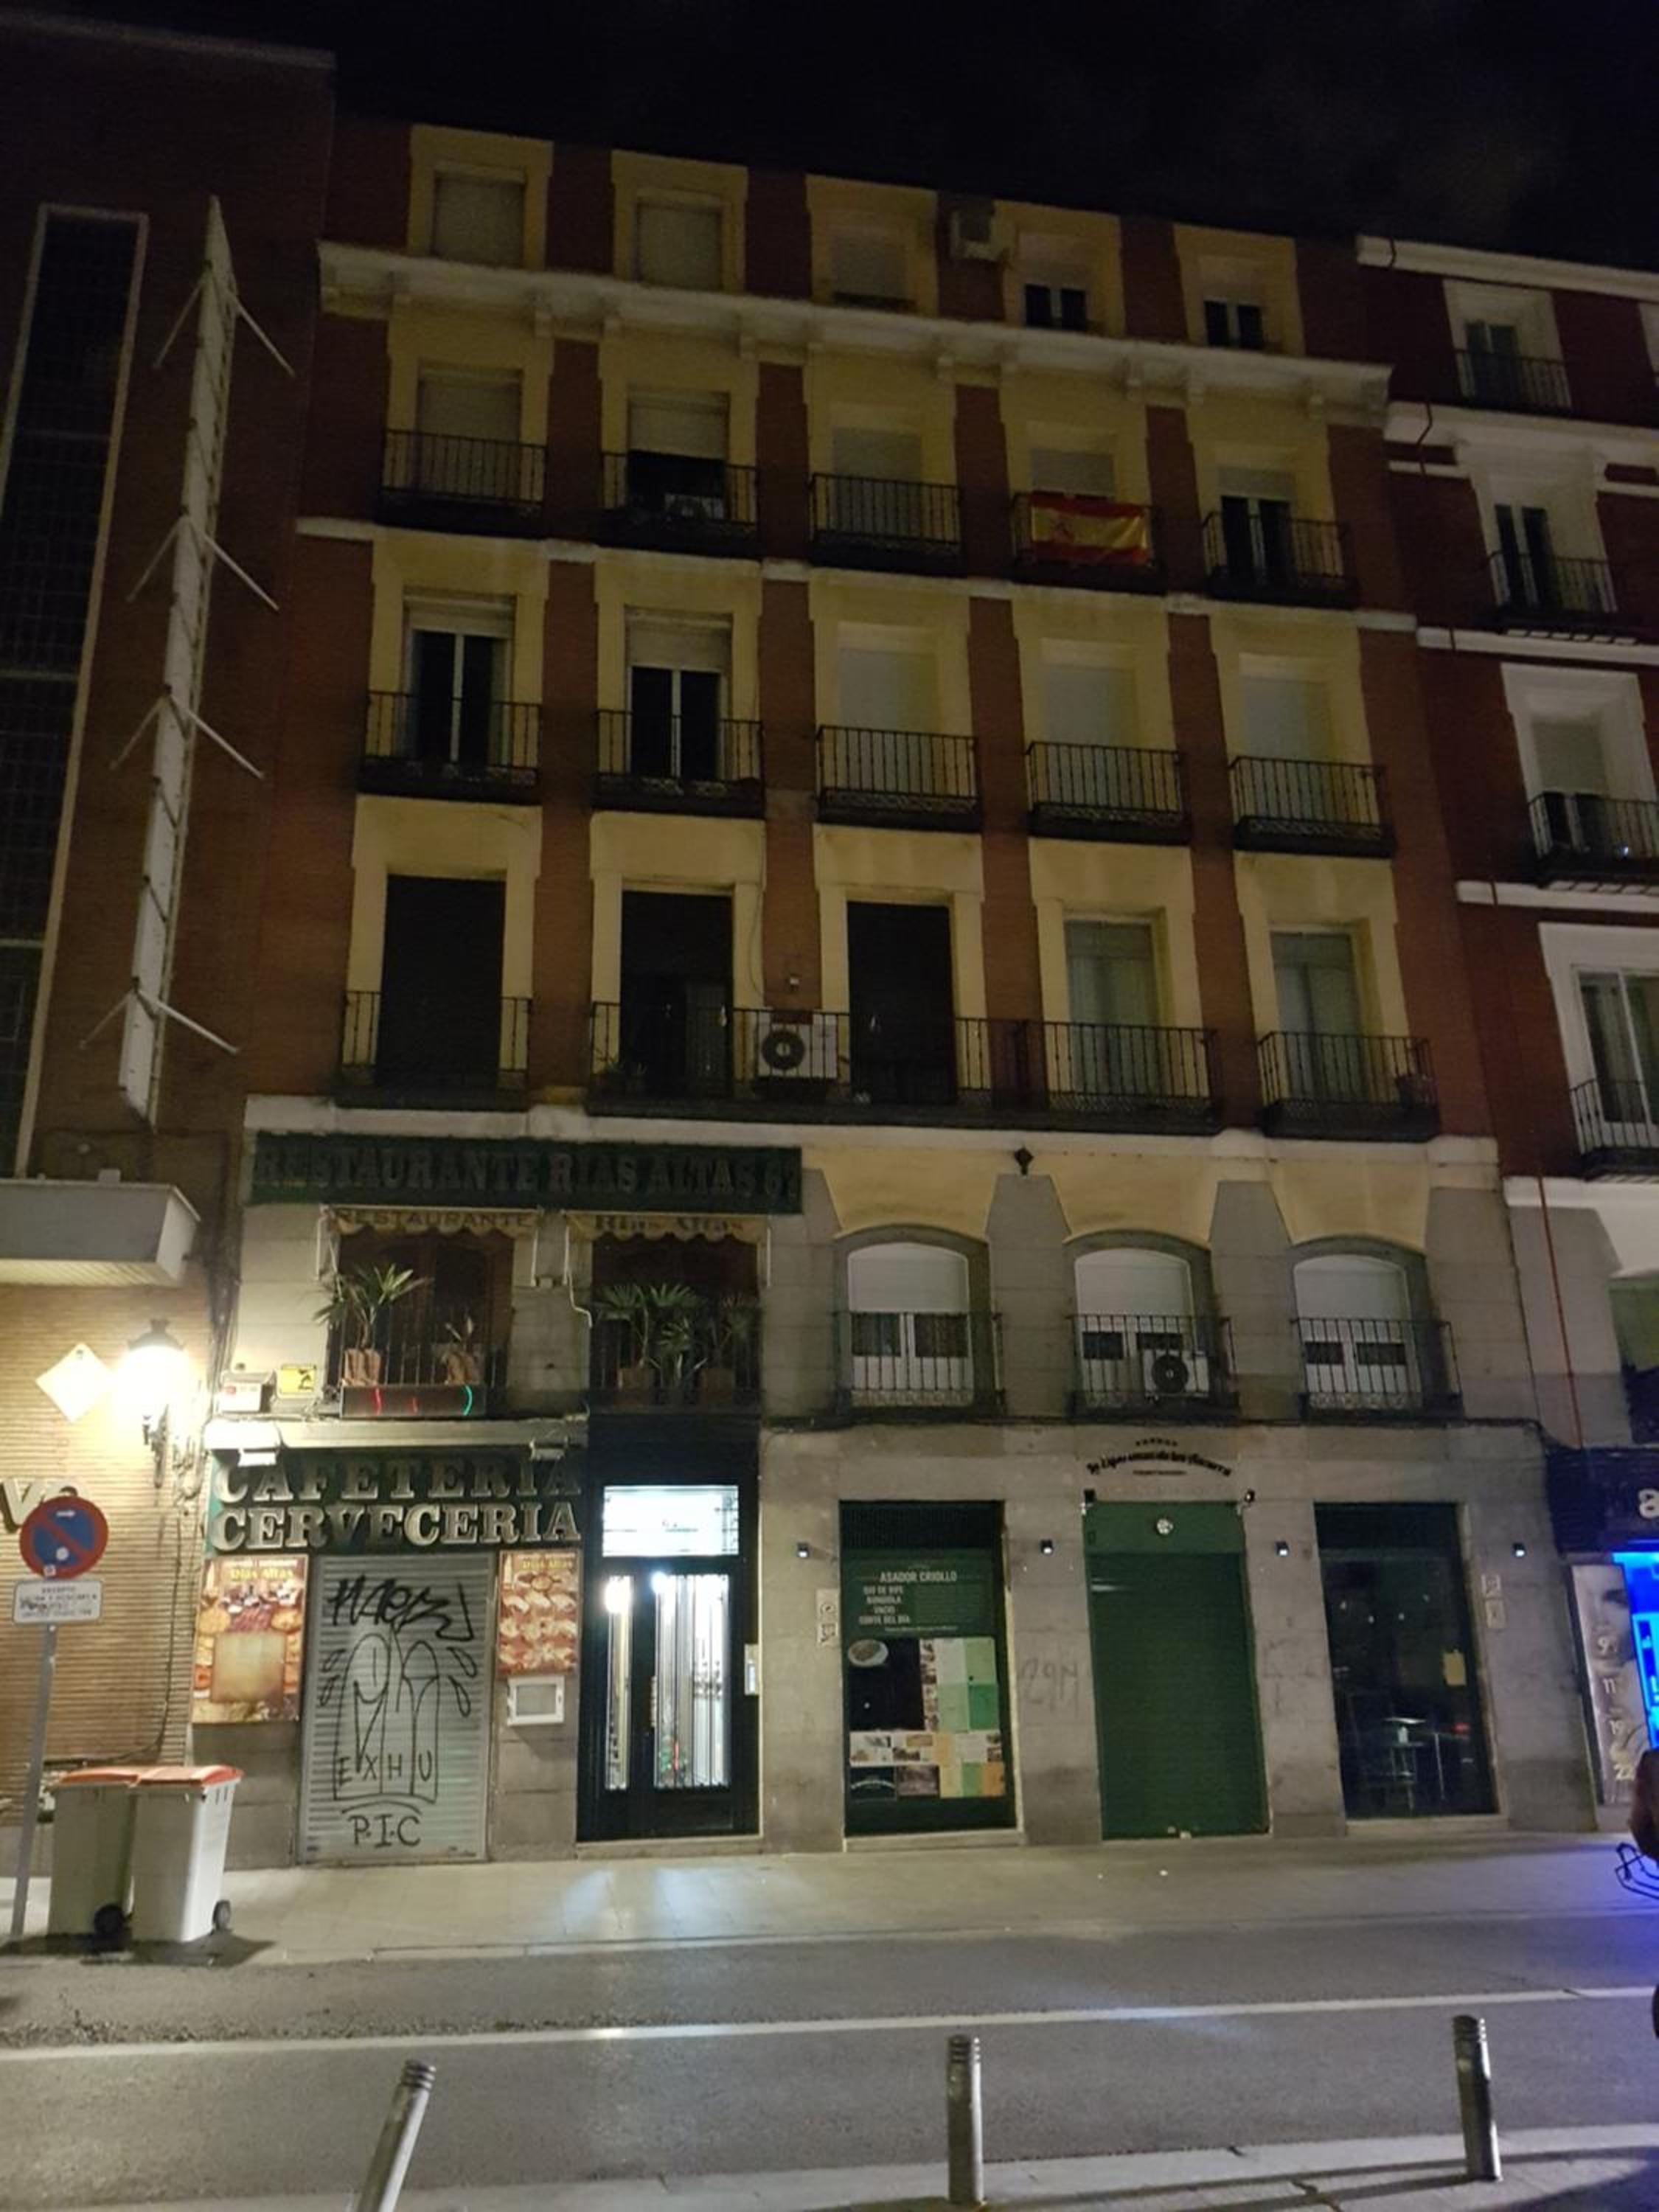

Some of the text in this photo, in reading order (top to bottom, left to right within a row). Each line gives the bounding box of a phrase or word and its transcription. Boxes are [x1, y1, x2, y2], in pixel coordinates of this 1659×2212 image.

[255, 1147, 536, 1192] RESTAURANTE
[548, 1152, 639, 1194] RIAS
[645, 1155, 756, 1198] ALTAS
[335, 1210, 536, 1228] RESTAURANTE
[212, 1455, 582, 1503] CAFETERIA
[212, 1501, 582, 1551] CERVECERIA
[879, 1571, 917, 1583] ASADOR
